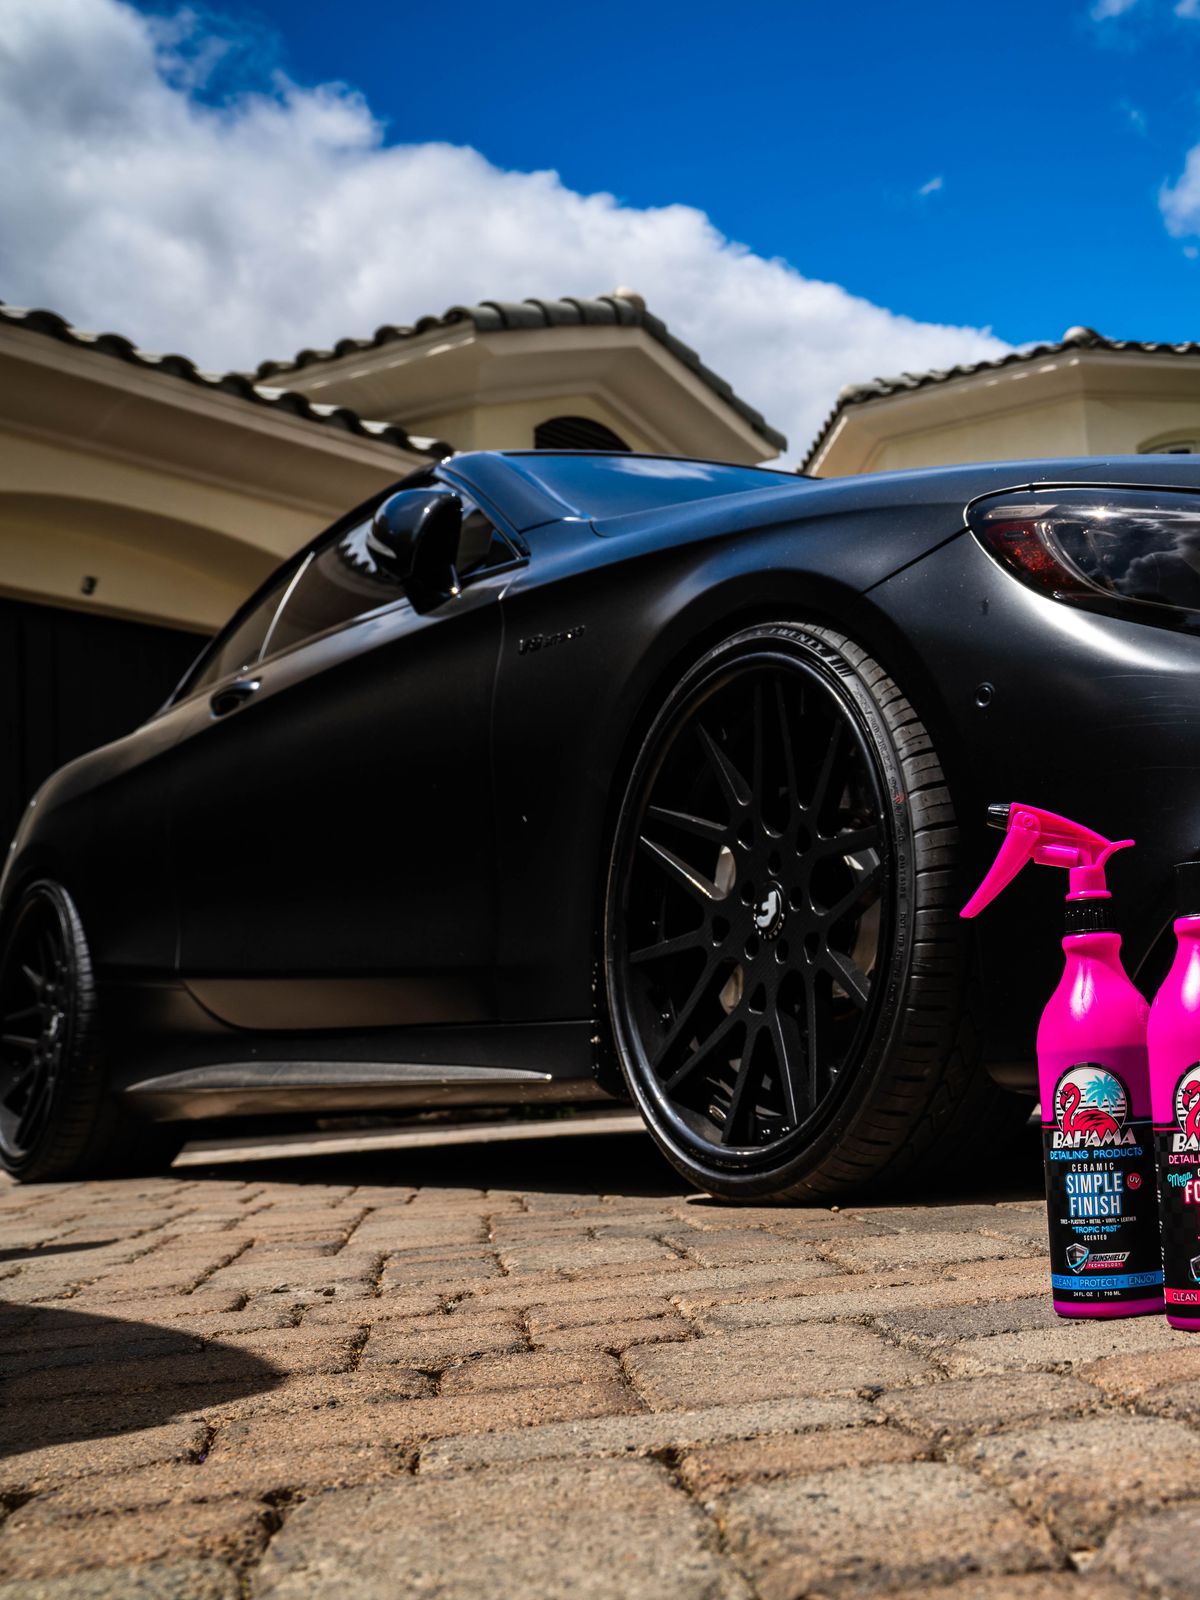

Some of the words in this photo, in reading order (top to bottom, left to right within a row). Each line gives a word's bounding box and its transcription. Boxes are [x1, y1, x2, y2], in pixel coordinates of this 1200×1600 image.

[1052, 1127, 1137, 1149] BAHAMA
[1049, 1150, 1089, 1160] DETAILING
[1093, 1147, 1143, 1159] PRODUCTS
[1071, 1162, 1115, 1173] CERAMIC
[1066, 1172, 1123, 1195] SIMPLE
[1129, 1175, 1140, 1184] UV
[1167, 1171, 1193, 1188] Mega
[1070, 1194, 1121, 1217] FINISH
[1079, 1278, 1118, 1288] PROTECT
[1128, 1275, 1156, 1285] ENJOY
[1172, 1292, 1198, 1302] CLEAN
